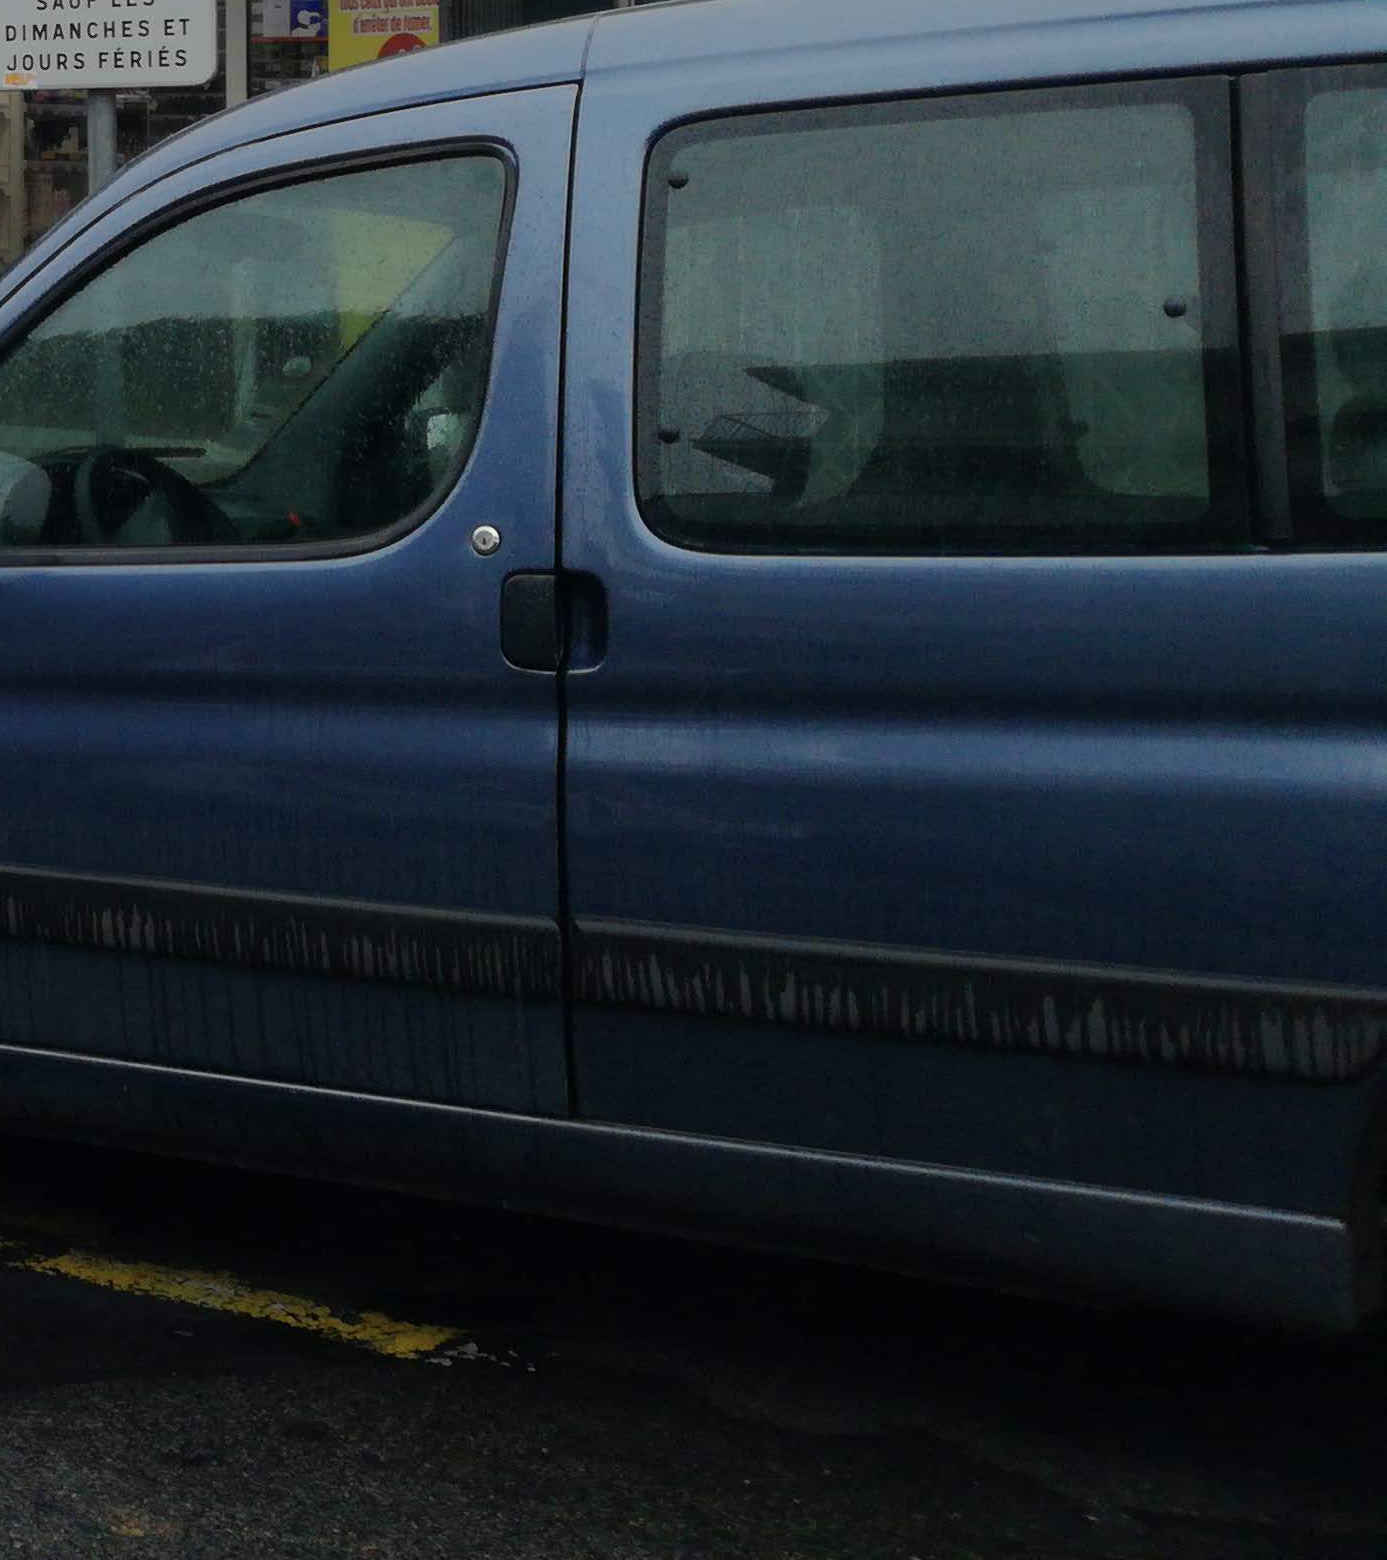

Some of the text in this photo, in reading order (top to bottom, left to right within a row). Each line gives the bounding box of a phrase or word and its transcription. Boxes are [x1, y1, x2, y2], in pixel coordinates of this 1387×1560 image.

[5, 18, 190, 42] DIMANCHES ET
[7, 46, 188, 71] JOURS FÉRIÉS
